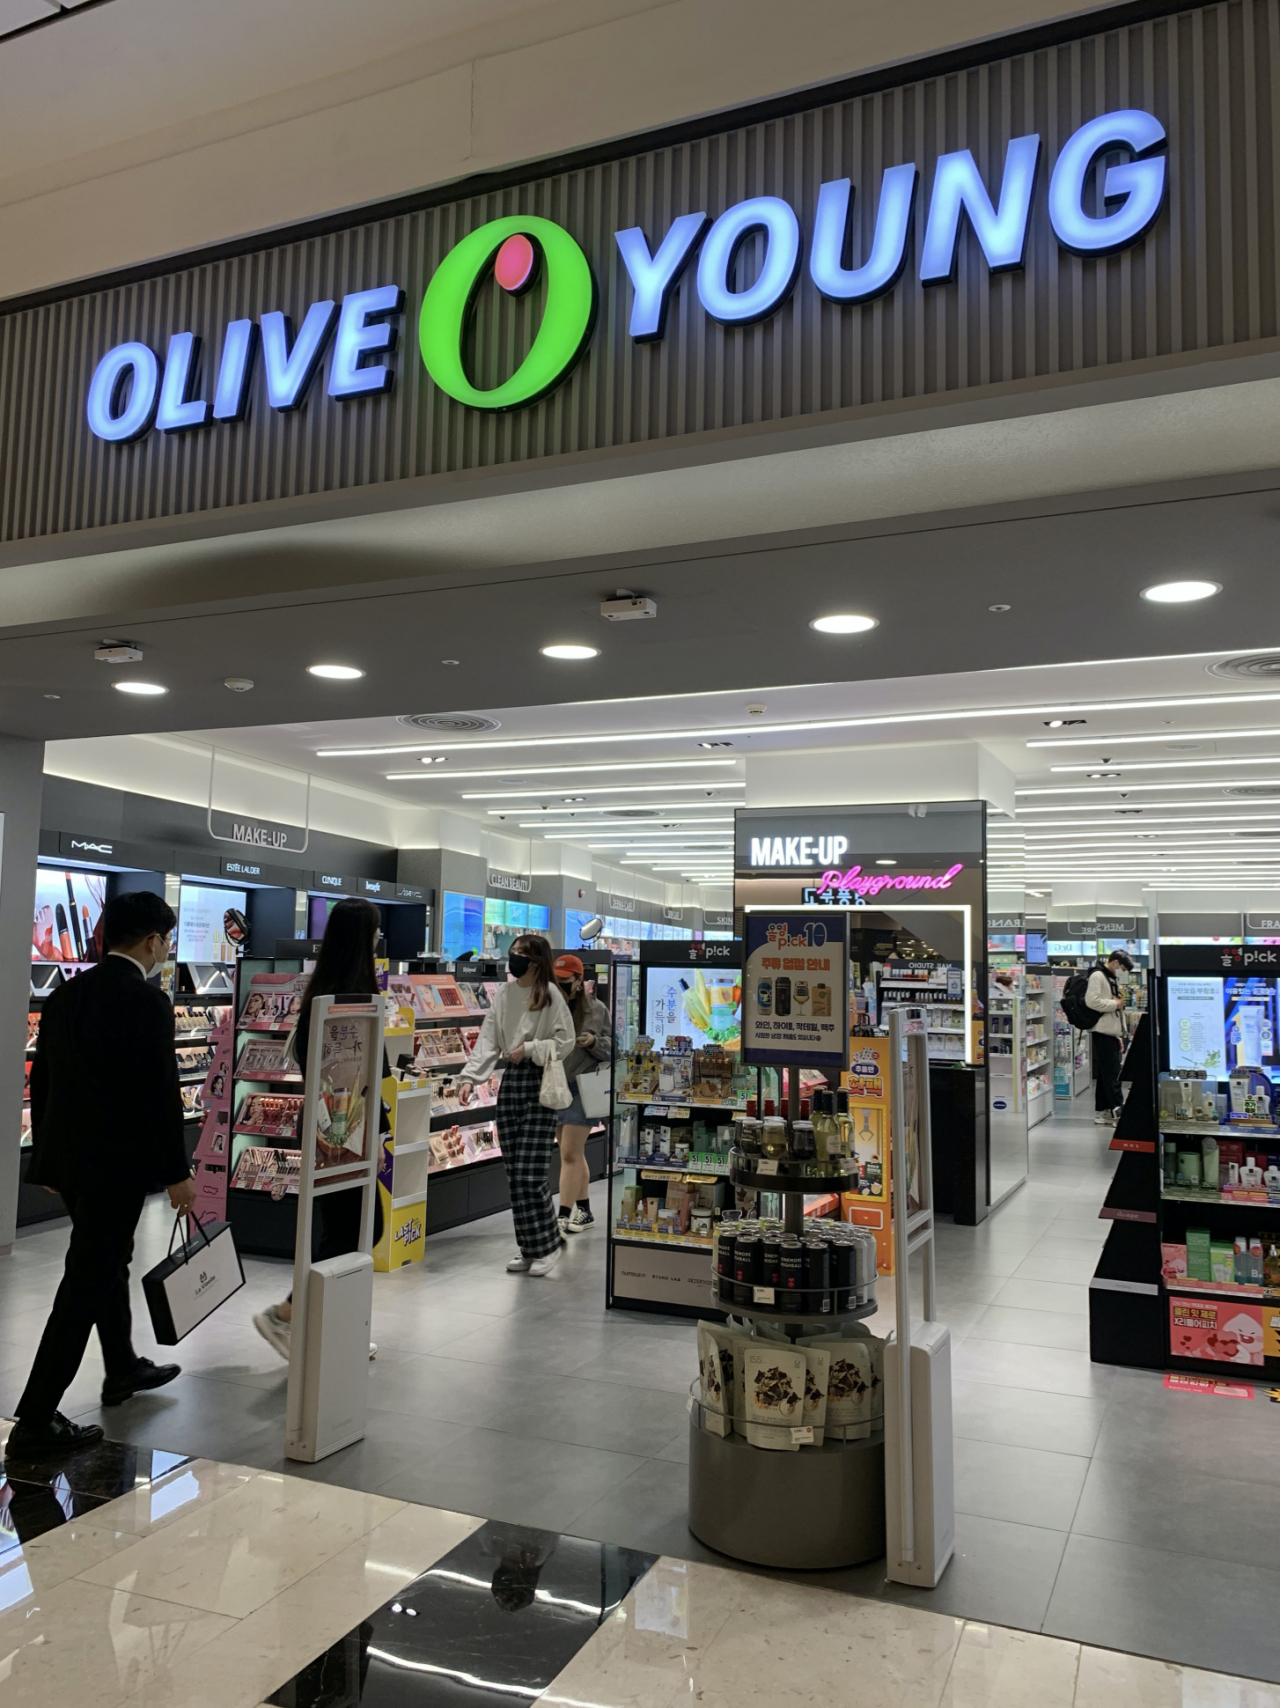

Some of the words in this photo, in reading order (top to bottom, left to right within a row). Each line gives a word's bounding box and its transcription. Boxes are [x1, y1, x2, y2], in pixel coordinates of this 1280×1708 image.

[87, 284, 403, 444] OLIVE
[614, 108, 1168, 340] YOUNG
[232, 823, 288, 848] MAKE-UP
[751, 835, 849, 866] MAKE-UP
[241, 864, 261, 877] LAUDER
[321, 875, 342, 886] CLINIQUE
[491, 874, 509, 889] CLEAN
[509, 877, 529, 891] BEAUTY
[816, 863, 965, 896] Playground
[716, 916, 733, 925] SKIN
[806, 957, 831, 972] 안내
[394, 1217, 414, 1242] LAST
[403, 1222, 422, 1247] PICK
